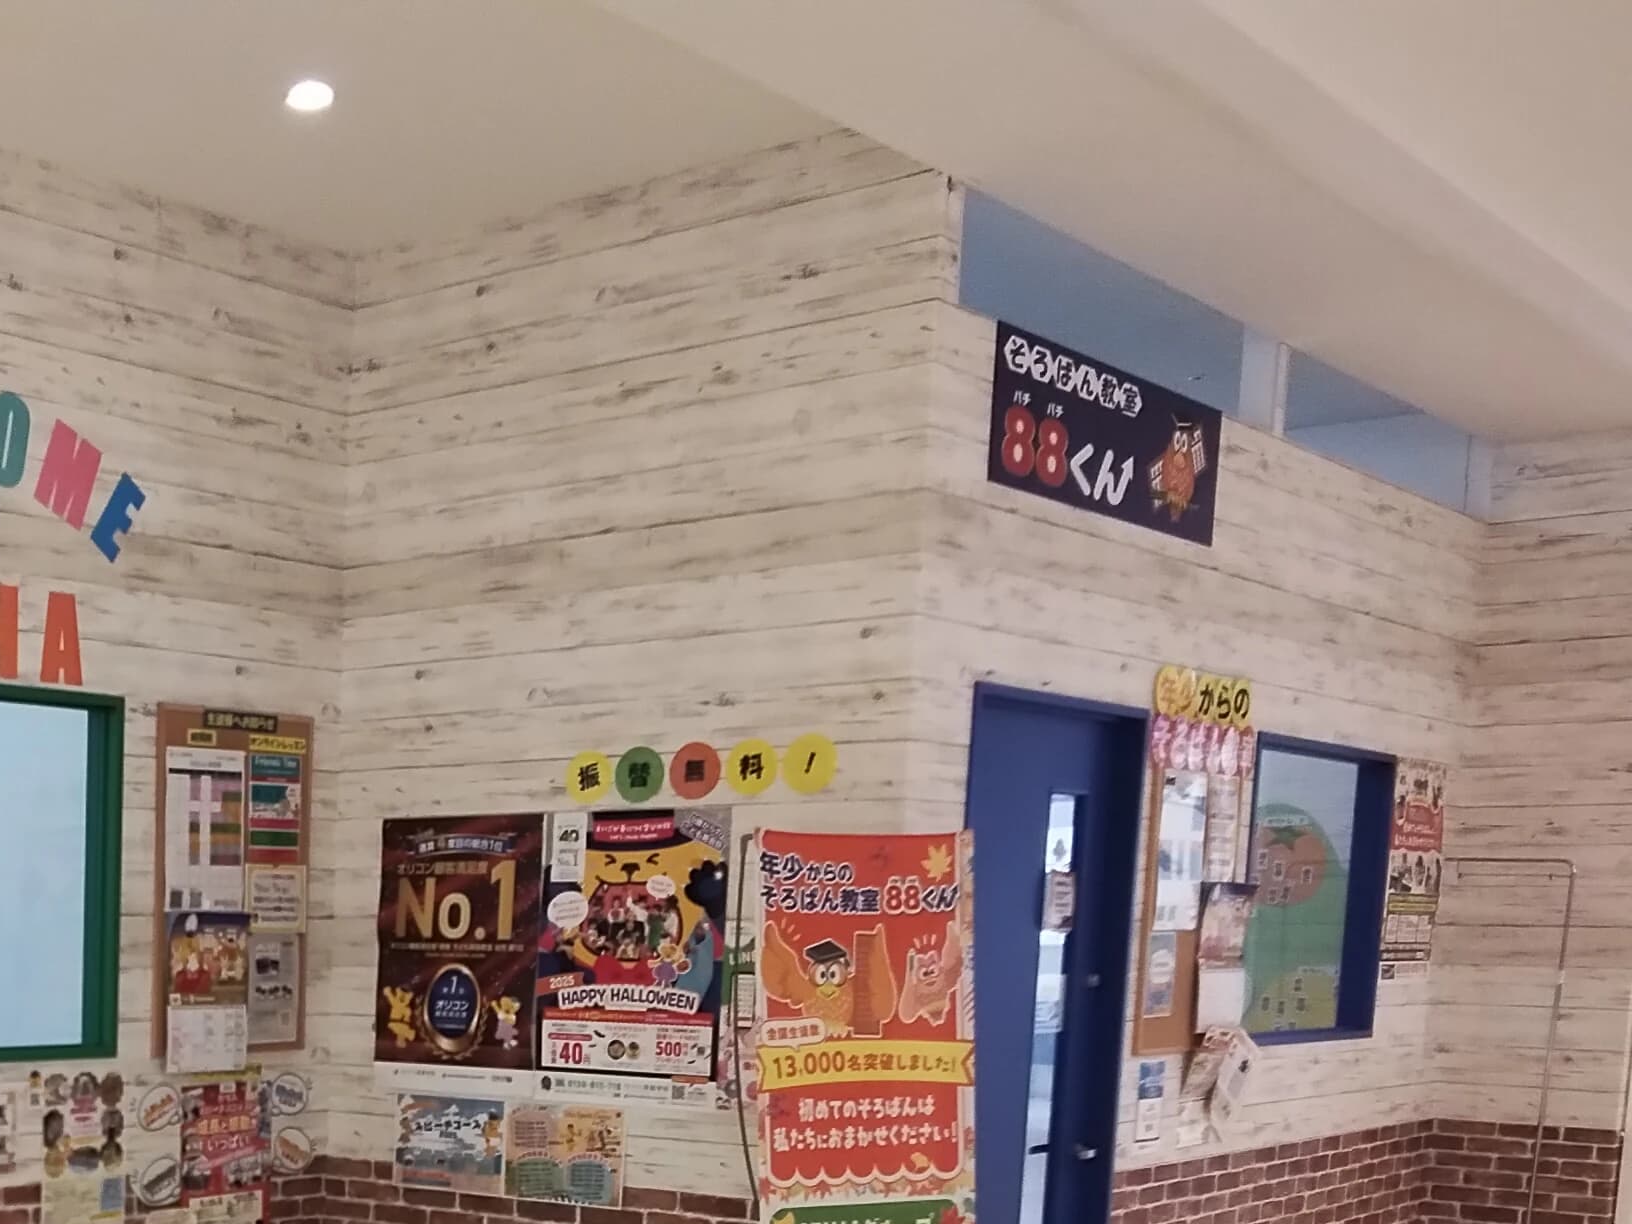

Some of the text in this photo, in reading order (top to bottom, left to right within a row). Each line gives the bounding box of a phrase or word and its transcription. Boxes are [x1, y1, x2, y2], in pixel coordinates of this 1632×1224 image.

[1004, 335, 1143, 417] そろばん教室
[1002, 404, 1135, 506] 88くん
[760, 851, 853, 882] 年少からの
[394, 860, 517, 940] No.1
[550, 976, 575, 987] 2025
[561, 984, 697, 1009] HAPPY HALLOWEEN
[560, 1042, 583, 1065] 40
[655, 1041, 682, 1057] 500
[798, 1094, 936, 1122] 初めてのそろばんは
[414, 1119, 482, 1132] スピーチコース
